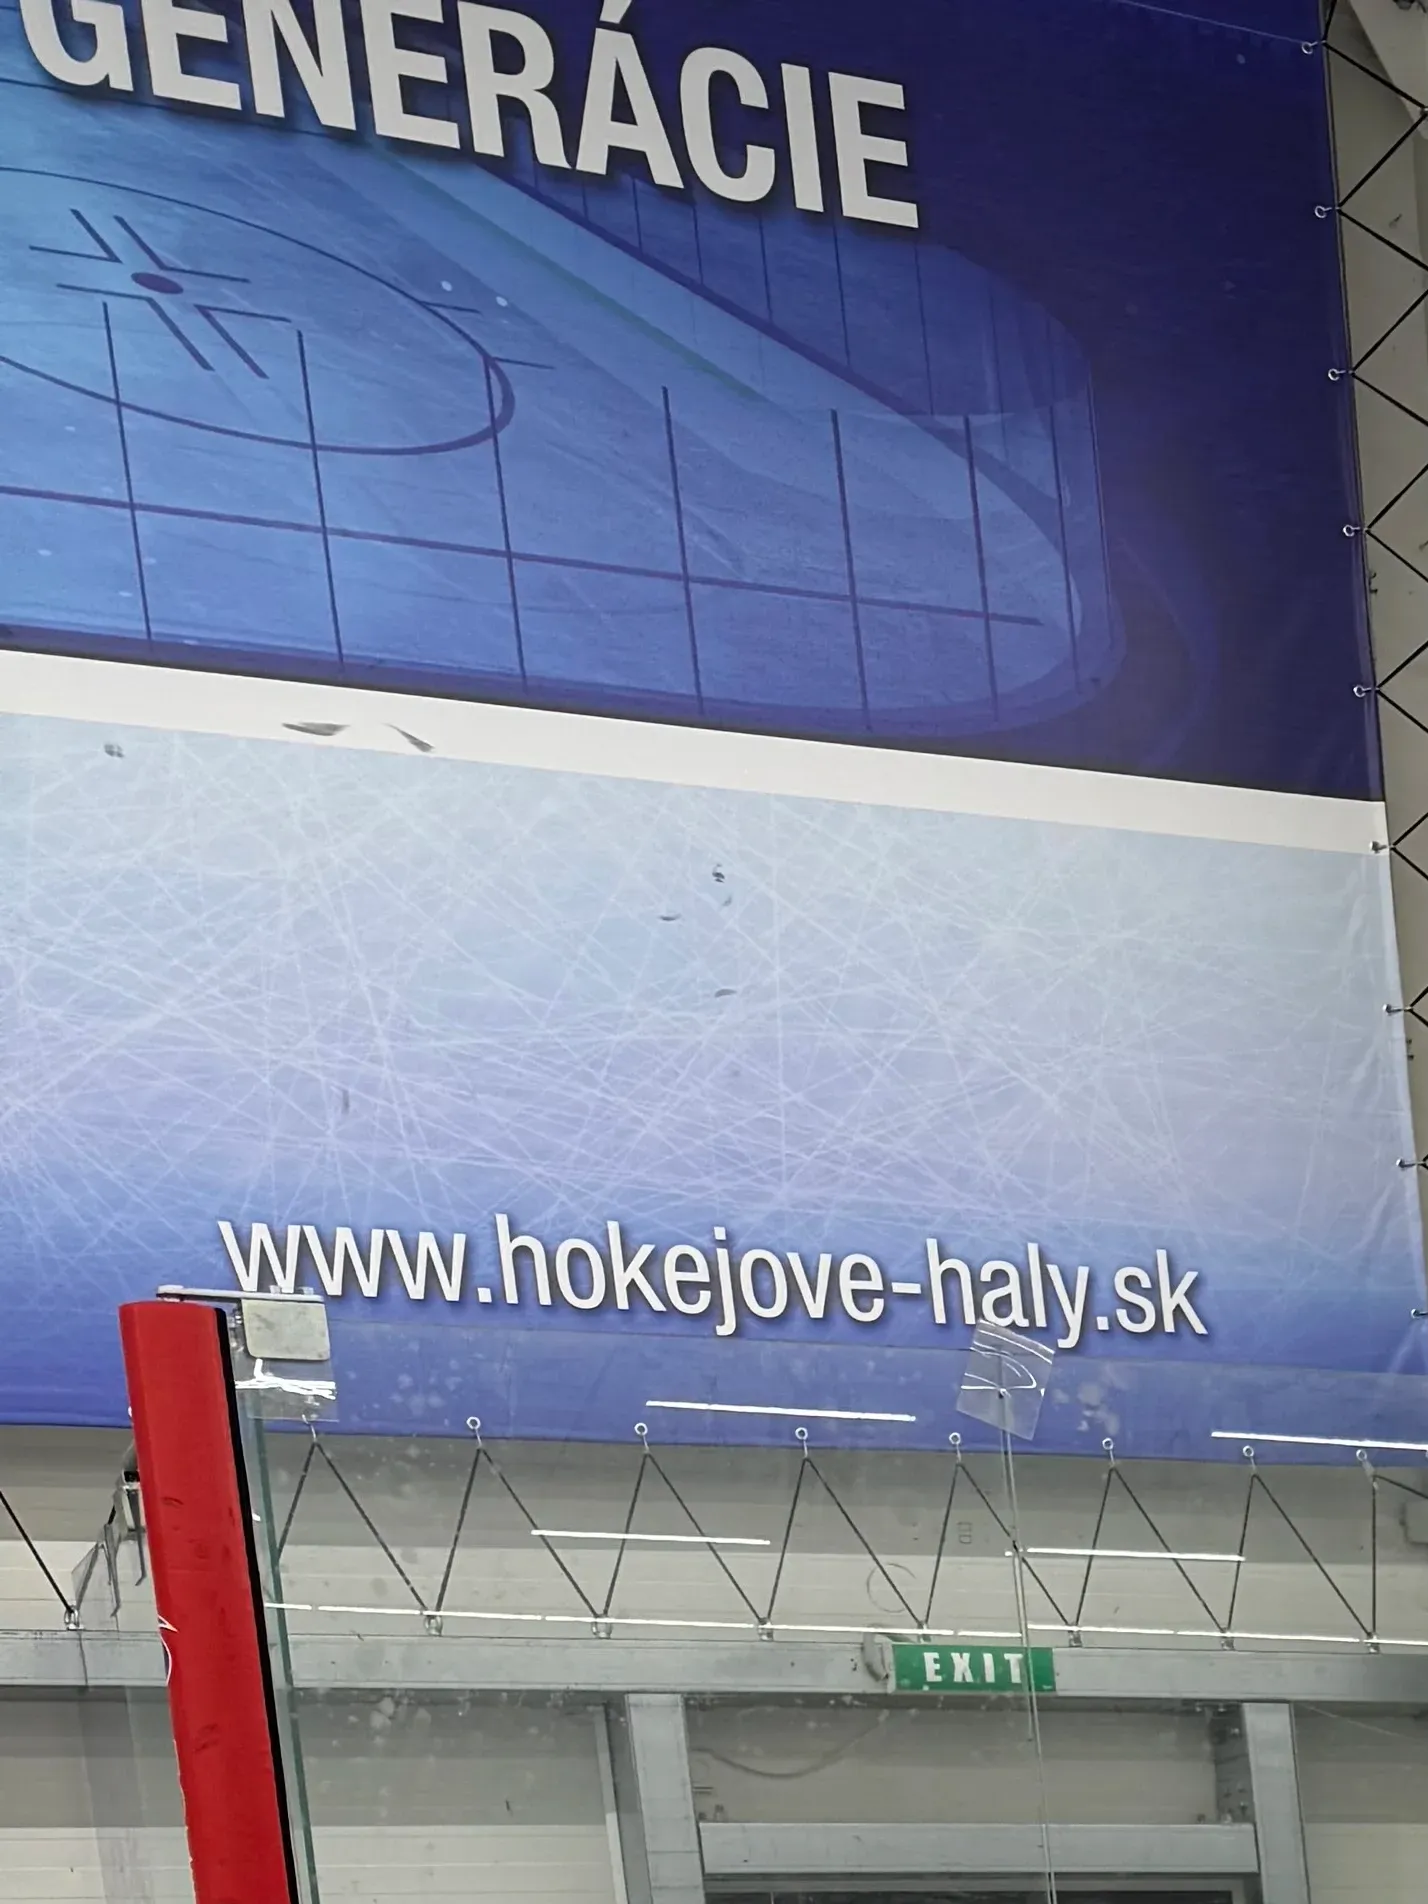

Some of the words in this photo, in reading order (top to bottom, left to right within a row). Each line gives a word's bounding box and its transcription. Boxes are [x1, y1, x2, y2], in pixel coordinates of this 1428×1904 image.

[21, 0, 921, 229] GENERÁCIE
[218, 1214, 1208, 1348] www.hokejove-haly.sk
[924, 1652, 1026, 1685] EXIT
